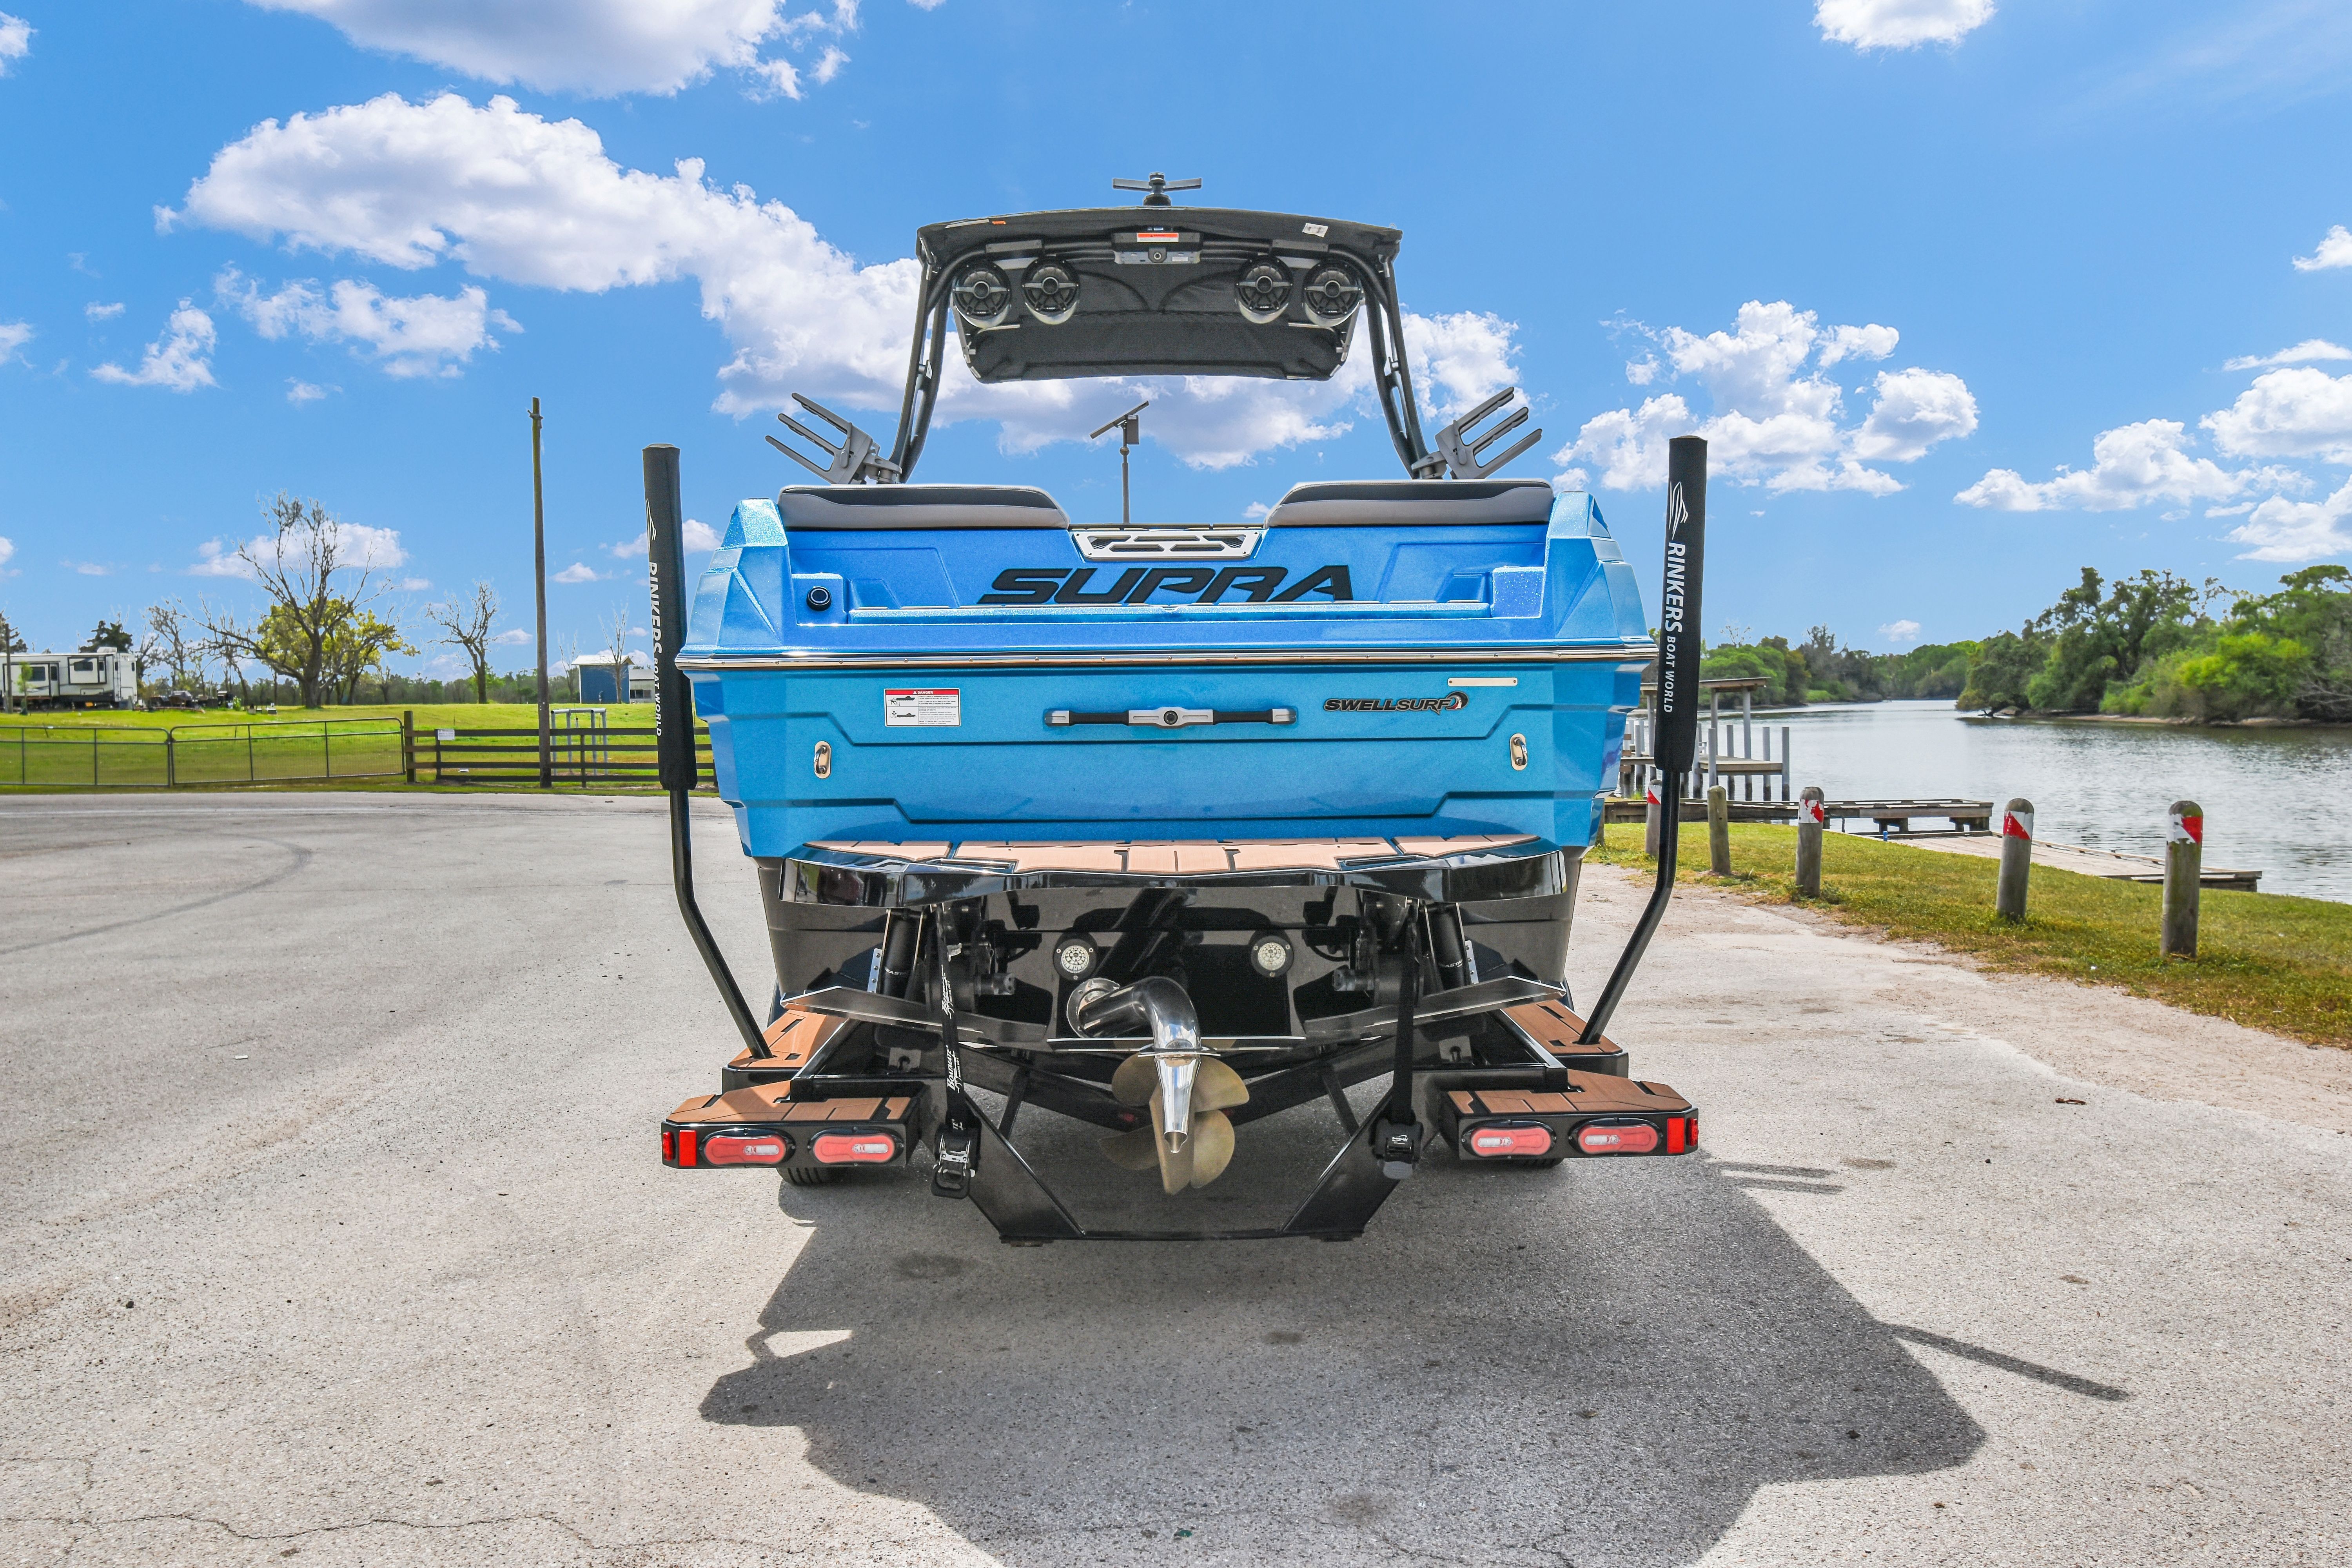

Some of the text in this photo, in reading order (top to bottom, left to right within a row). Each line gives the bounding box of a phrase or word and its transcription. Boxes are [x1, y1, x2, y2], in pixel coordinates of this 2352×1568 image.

[976, 564, 1354, 605] SUPRA
[649, 562, 662, 654] RINKERS
[1664, 542, 1686, 713] RINKERS BOAT WORLD
[1324, 698, 1452, 715] SWELLSURF
[946, 1047, 956, 1091] BOATMATE
